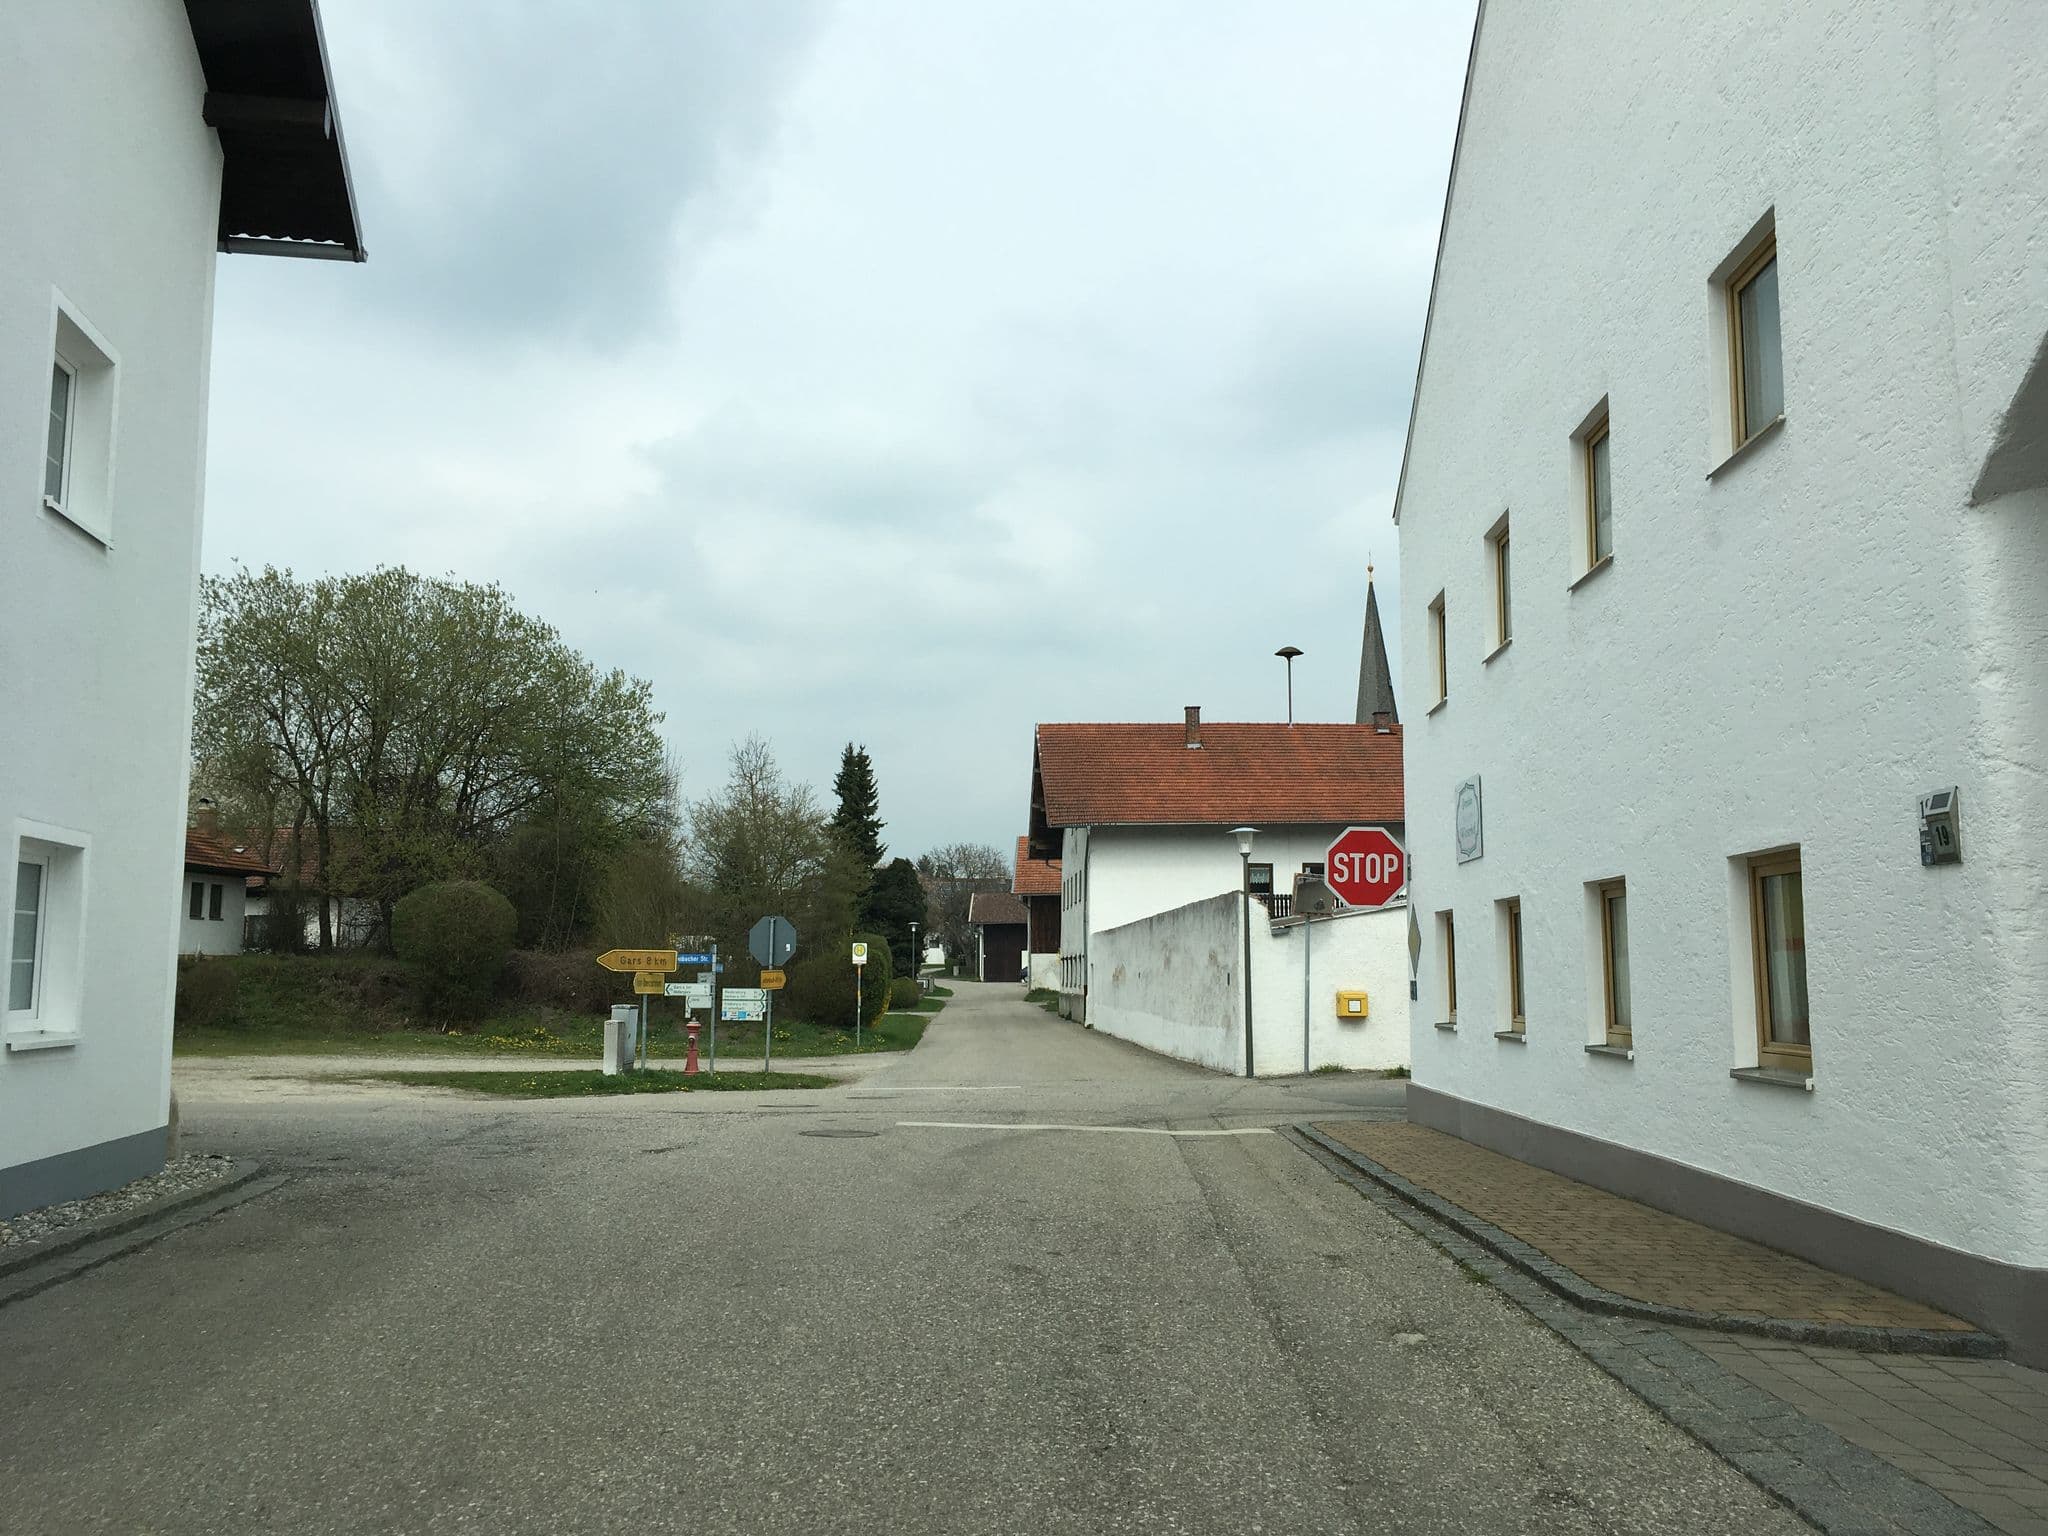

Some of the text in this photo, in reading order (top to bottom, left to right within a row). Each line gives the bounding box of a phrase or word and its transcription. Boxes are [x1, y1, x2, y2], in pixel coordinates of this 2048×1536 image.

[1936, 825, 1949, 846] 19
[1333, 852, 1399, 884] STOP
[619, 956, 668, 966] Gars 8 km
